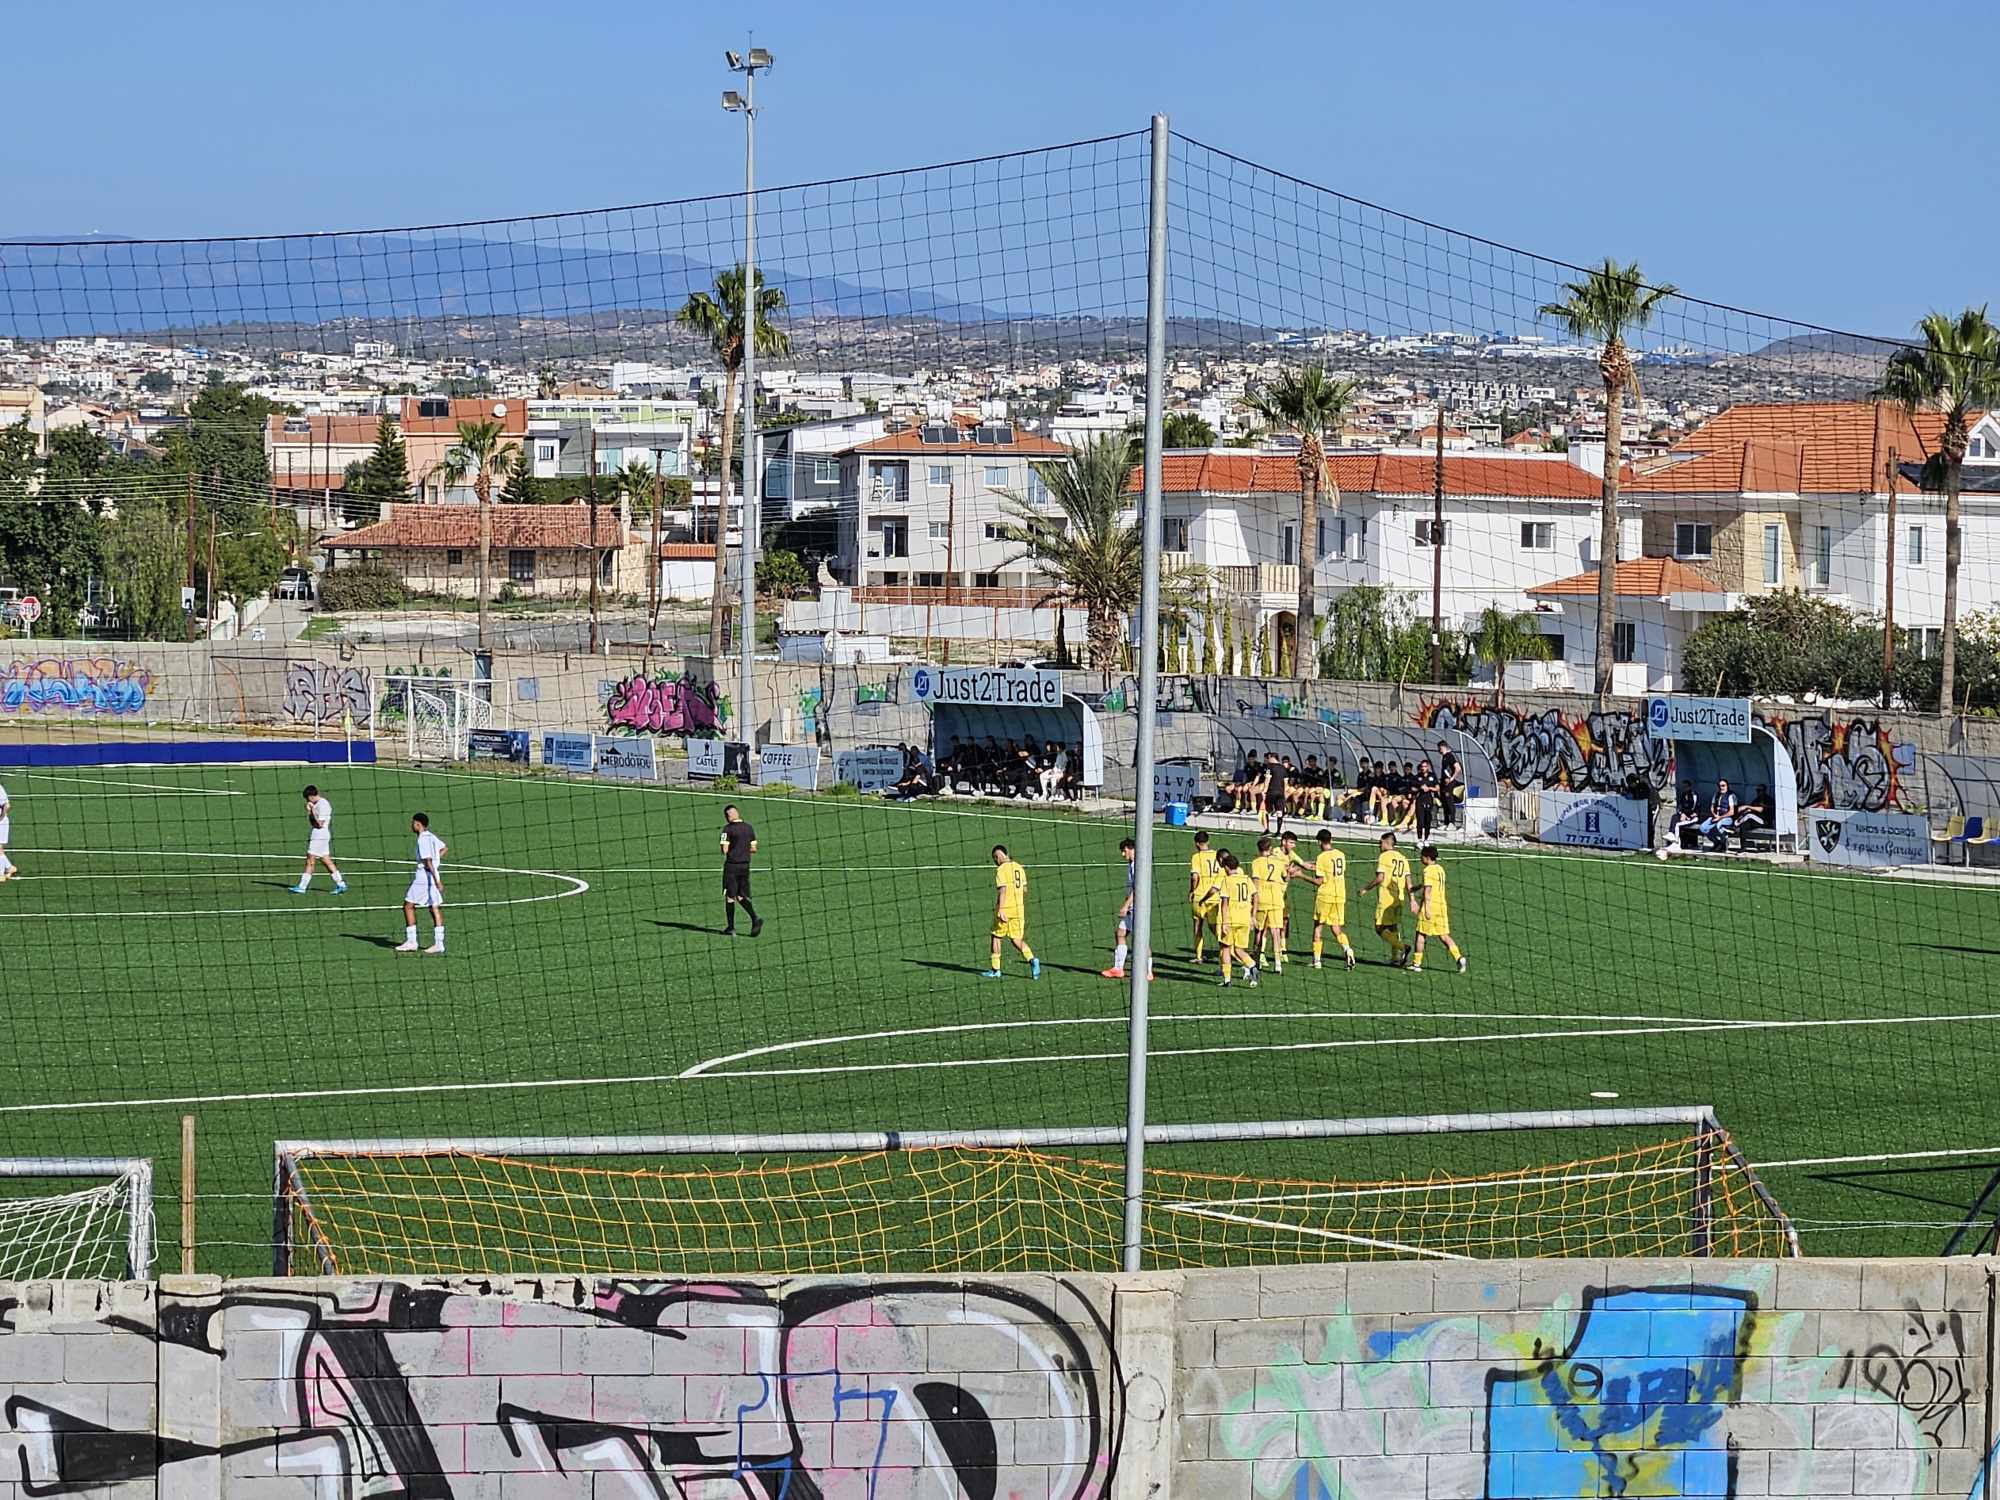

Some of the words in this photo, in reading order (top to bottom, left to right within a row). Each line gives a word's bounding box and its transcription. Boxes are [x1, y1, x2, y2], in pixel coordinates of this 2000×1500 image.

[933, 670, 1056, 703] Just2Trade
[1671, 707, 1745, 727] Just2Trade
[696, 757, 719, 767] CASTLE
[762, 752, 792, 766] COFFEE
[1153, 775, 1195, 788] OLVO
[1153, 791, 1194, 803] ENTA
[1266, 863, 1275, 882] 2
[1330, 857, 1344, 877] 19
[1391, 858, 1405, 878] 20
[1014, 870, 1021, 889] 9
[1236, 882, 1249, 902] 10
